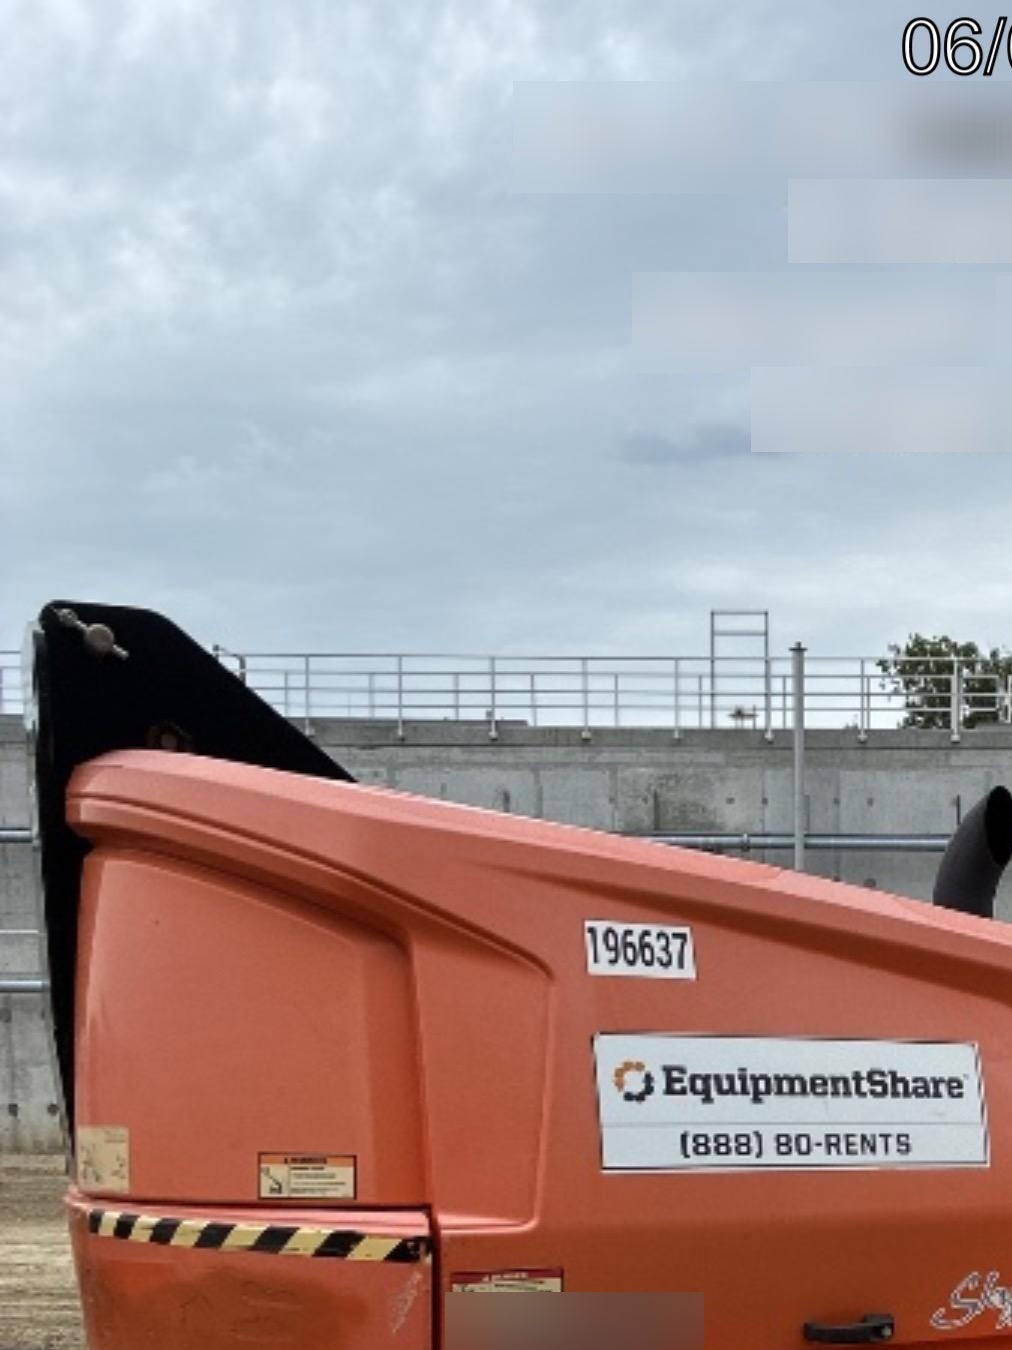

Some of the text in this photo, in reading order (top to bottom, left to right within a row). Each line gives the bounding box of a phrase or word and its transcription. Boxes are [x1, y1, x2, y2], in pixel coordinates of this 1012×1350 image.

[587, 926, 688, 969] 196637
[662, 1065, 965, 1104] EquipmentShare
[680, 1131, 912, 1159] (888) 80-RENTS
